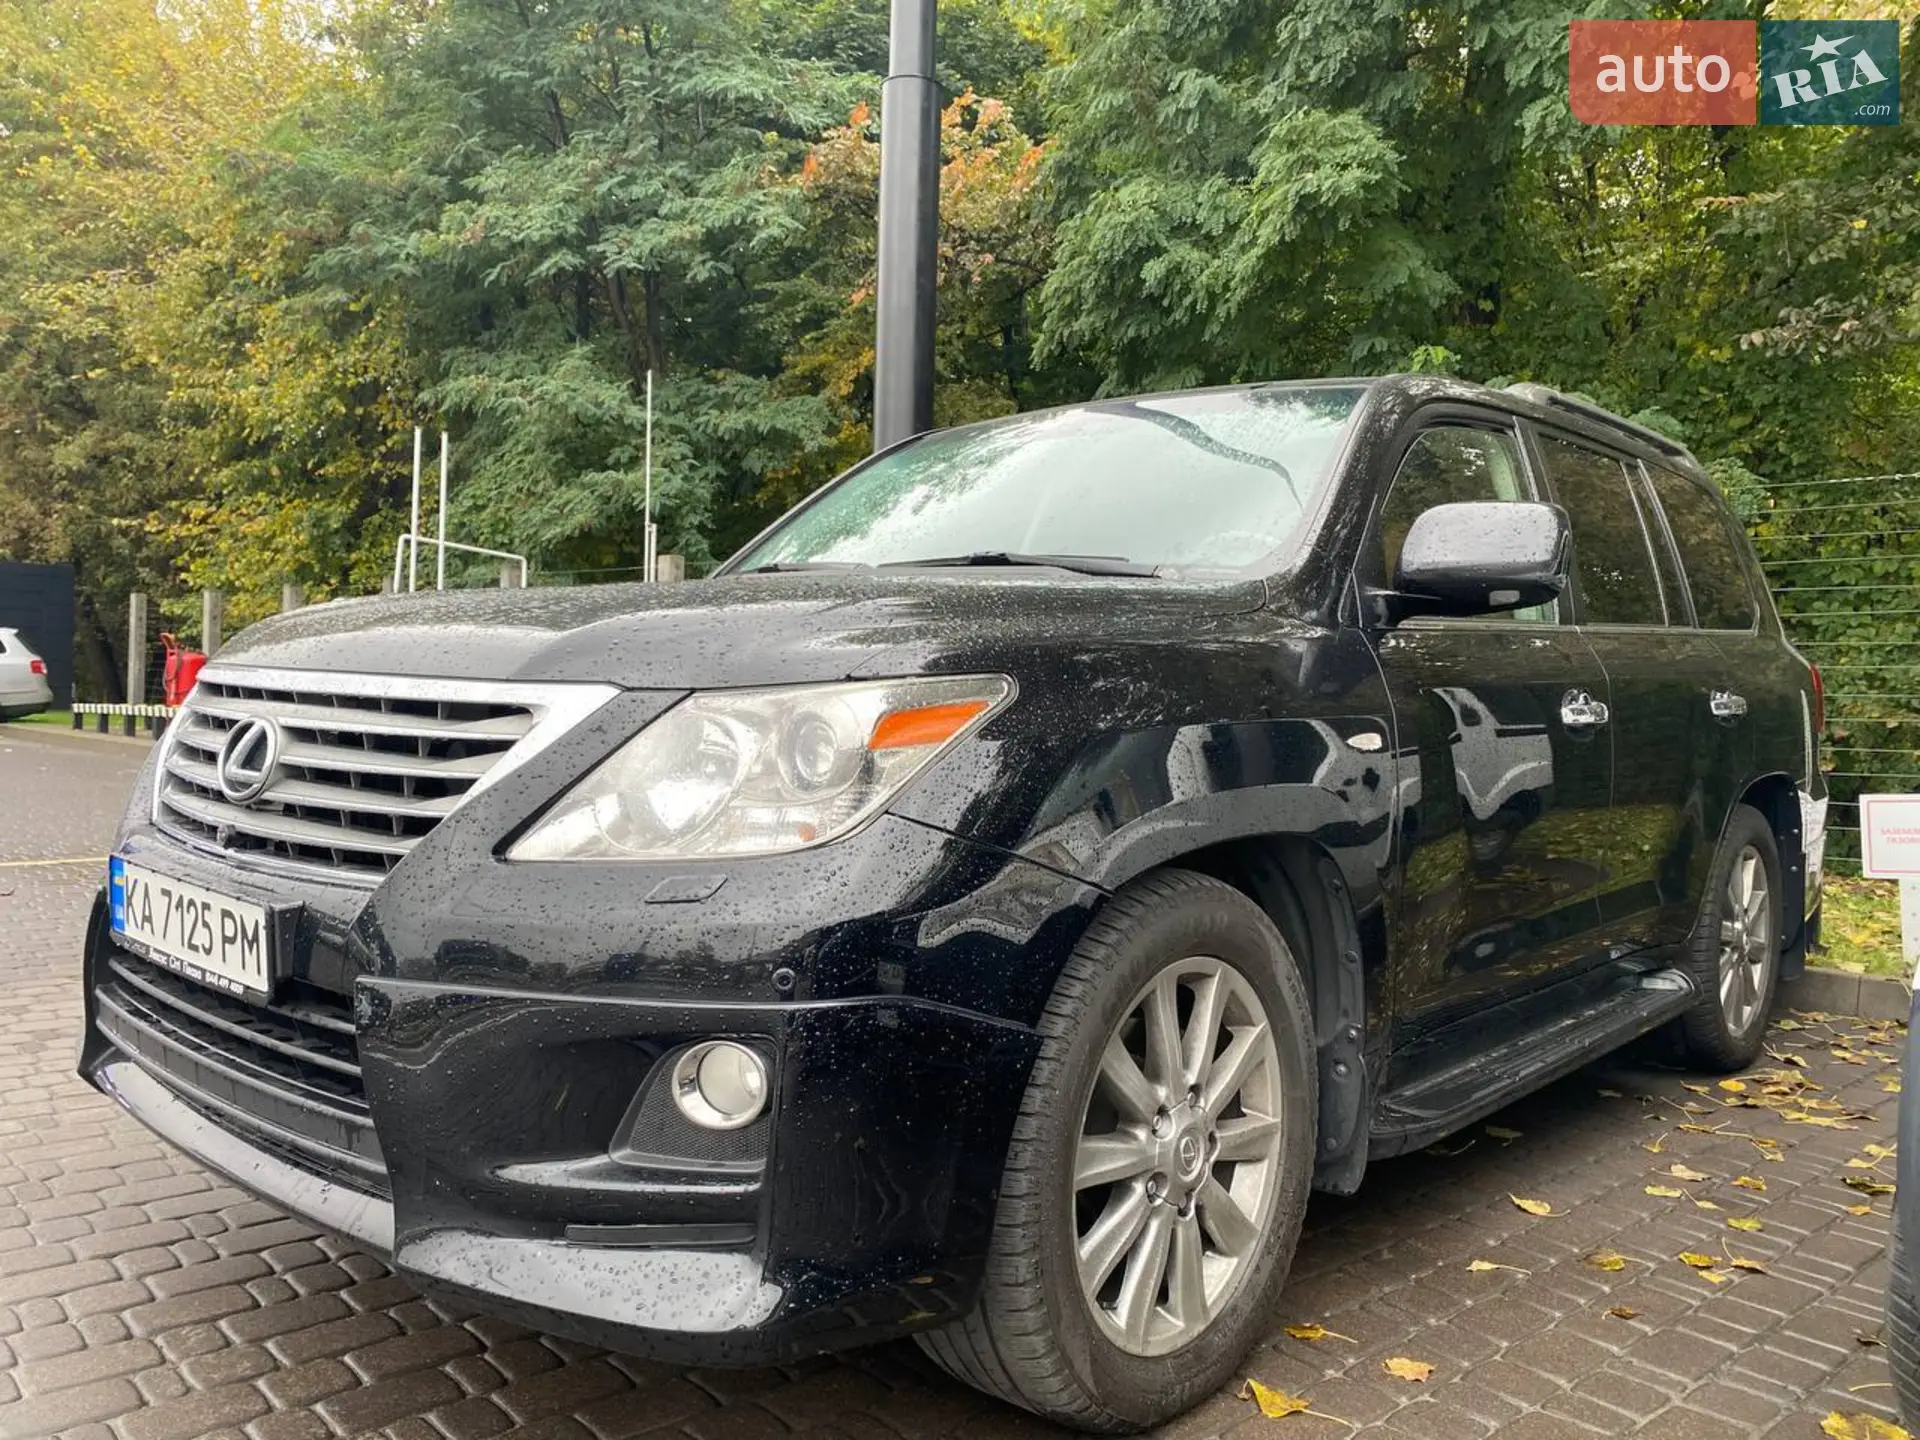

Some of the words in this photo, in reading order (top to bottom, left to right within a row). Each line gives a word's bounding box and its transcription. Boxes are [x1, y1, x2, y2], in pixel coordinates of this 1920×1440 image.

[125, 875, 155, 935] KA
[161, 888, 214, 956] 7125
[220, 908, 262, 977] PM
